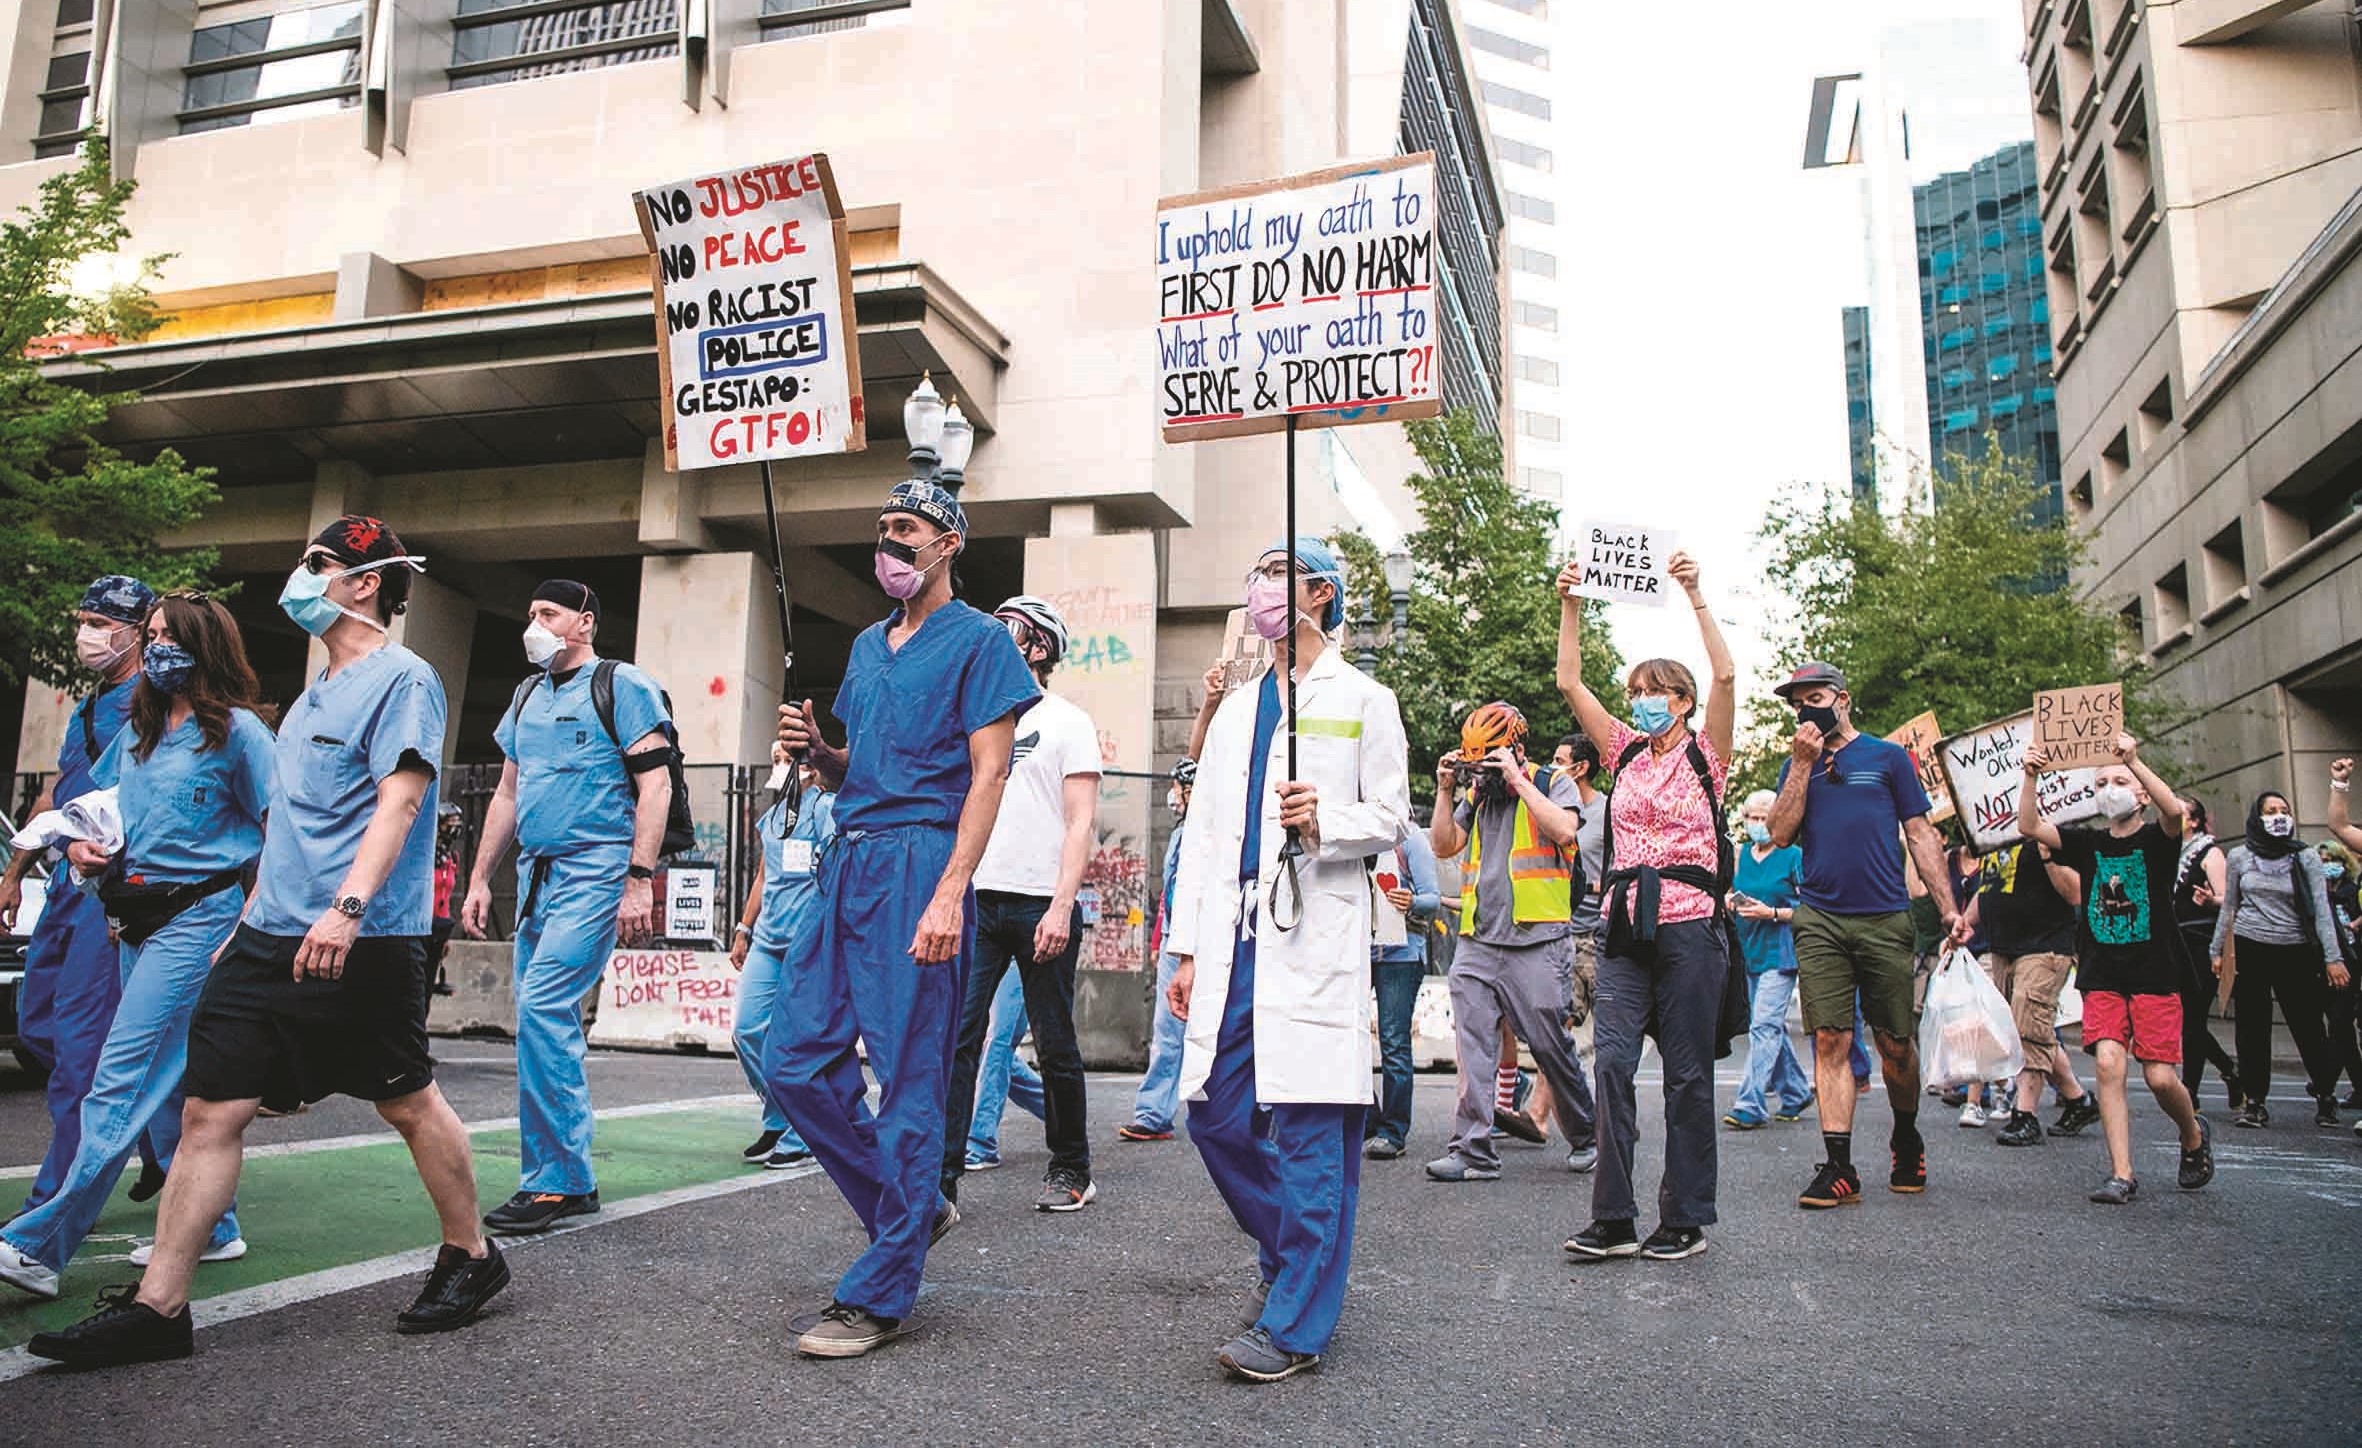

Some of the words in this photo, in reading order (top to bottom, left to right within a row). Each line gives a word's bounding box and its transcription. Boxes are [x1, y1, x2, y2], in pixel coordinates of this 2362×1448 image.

[646, 189, 693, 231] NO
[696, 157, 821, 218] JUSTICE
[1158, 222, 1170, 264] I
[1177, 204, 1252, 272] uphold
[1266, 212, 1303, 260] my
[1319, 181, 1372, 236] oath
[1392, 178, 1420, 228] to
[660, 243, 696, 285] NO
[703, 220, 806, 270] PEACE
[1161, 264, 1241, 317] FIRST
[1252, 259, 1289, 305] DO
[1302, 246, 1345, 297] NO
[1356, 230, 1431, 290] HARM
[667, 300, 700, 335] NO
[708, 277, 817, 327] RACIST
[706, 323, 819, 371] POLICE
[1157, 320, 1208, 370] What
[1219, 313, 1241, 360] of
[1257, 323, 1311, 370] your
[1327, 293, 1382, 349] oath
[1397, 290, 1426, 341] to
[677, 376, 811, 416] GESTAPO:
[1164, 367, 1241, 416] SERVE
[1253, 371, 1277, 410] &
[710, 409, 822, 458] GTFO!
[1592, 528, 1649, 551] BLACK
[1592, 547, 1652, 570] LIVES
[1584, 567, 1658, 593] MATTER
[2038, 692, 2120, 722] BLACK
[2042, 715, 2112, 742] LIVES
[2044, 740, 2110, 762] MATTER
[1975, 786, 2017, 824] NOT
[683, 1005, 732, 1028] THE
